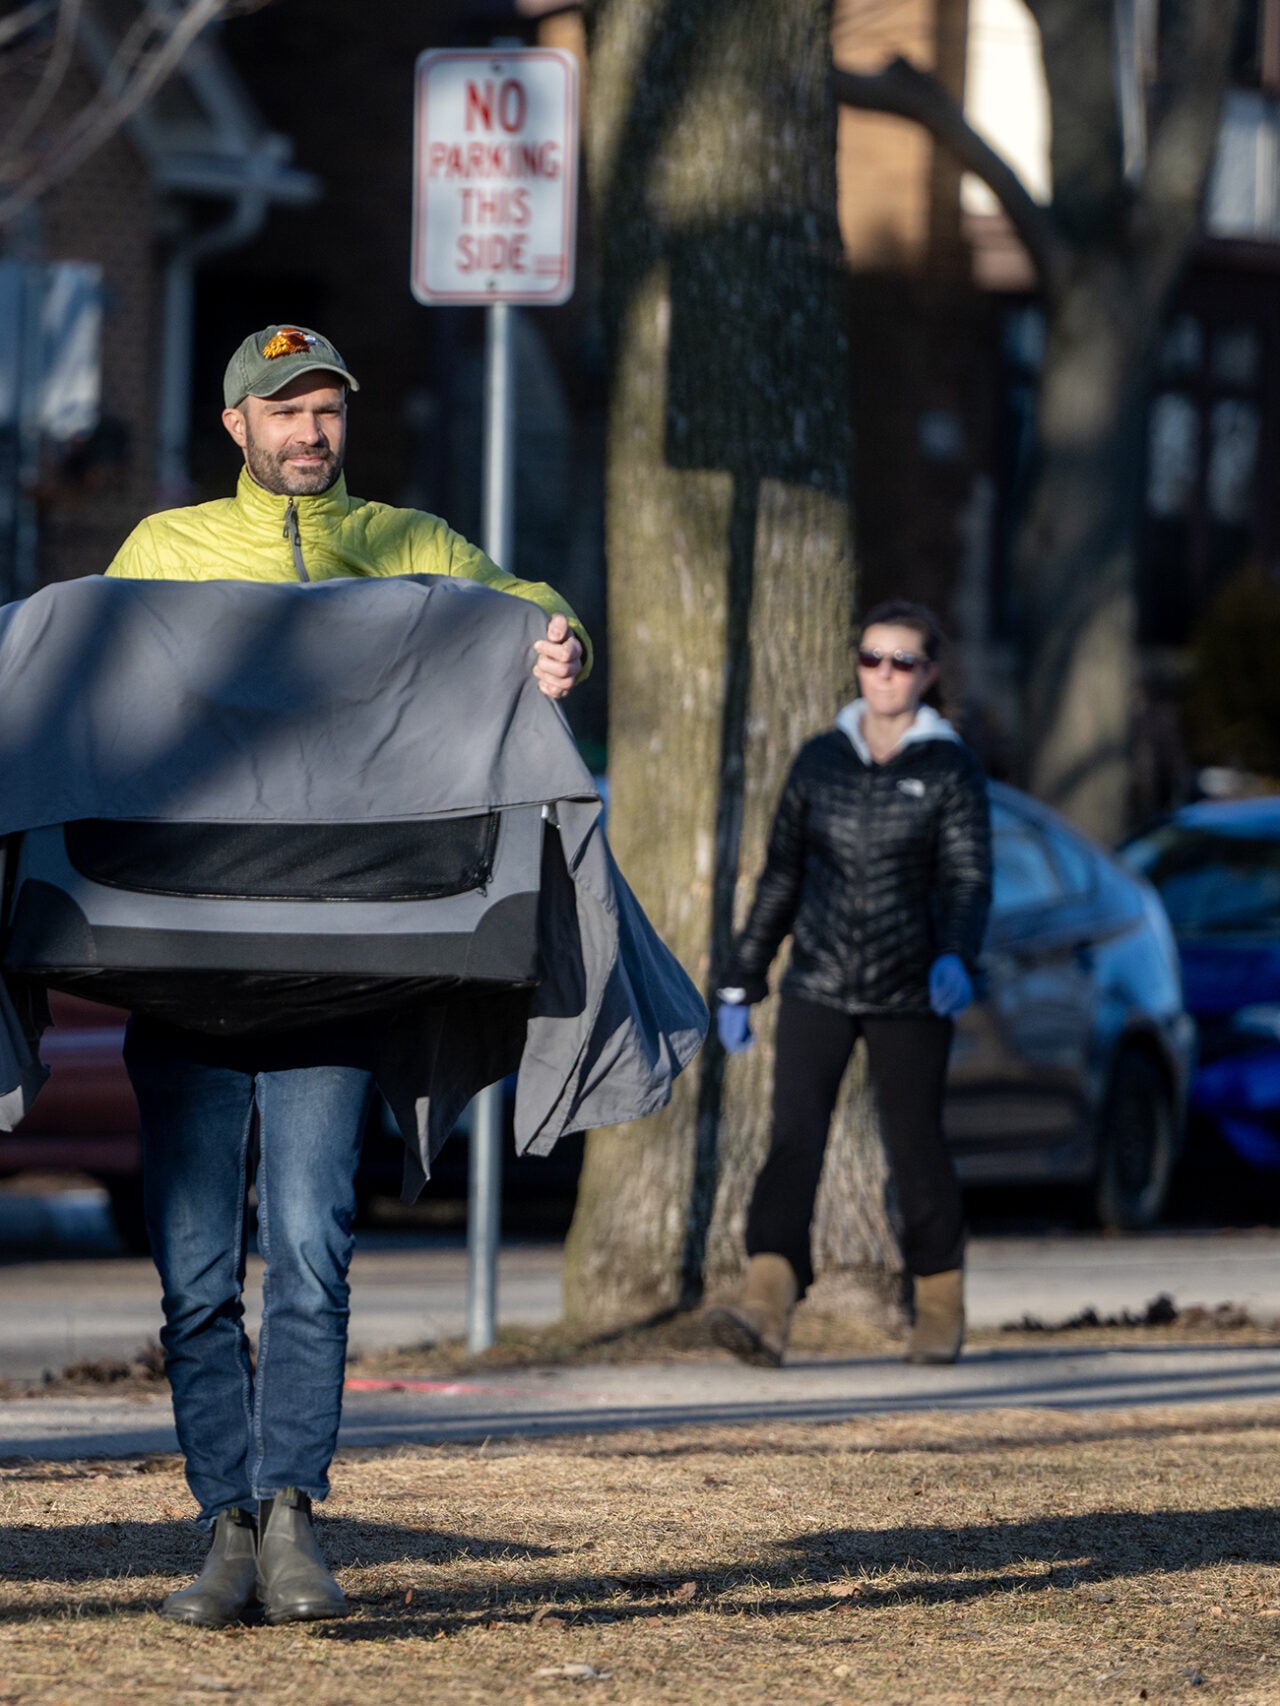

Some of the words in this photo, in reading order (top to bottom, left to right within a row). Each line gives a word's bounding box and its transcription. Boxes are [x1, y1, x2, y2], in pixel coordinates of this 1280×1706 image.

[464, 78, 528, 134] NO
[430, 140, 561, 180] PARKING
[459, 187, 532, 228] THIS
[456, 233, 529, 274] SIDE
